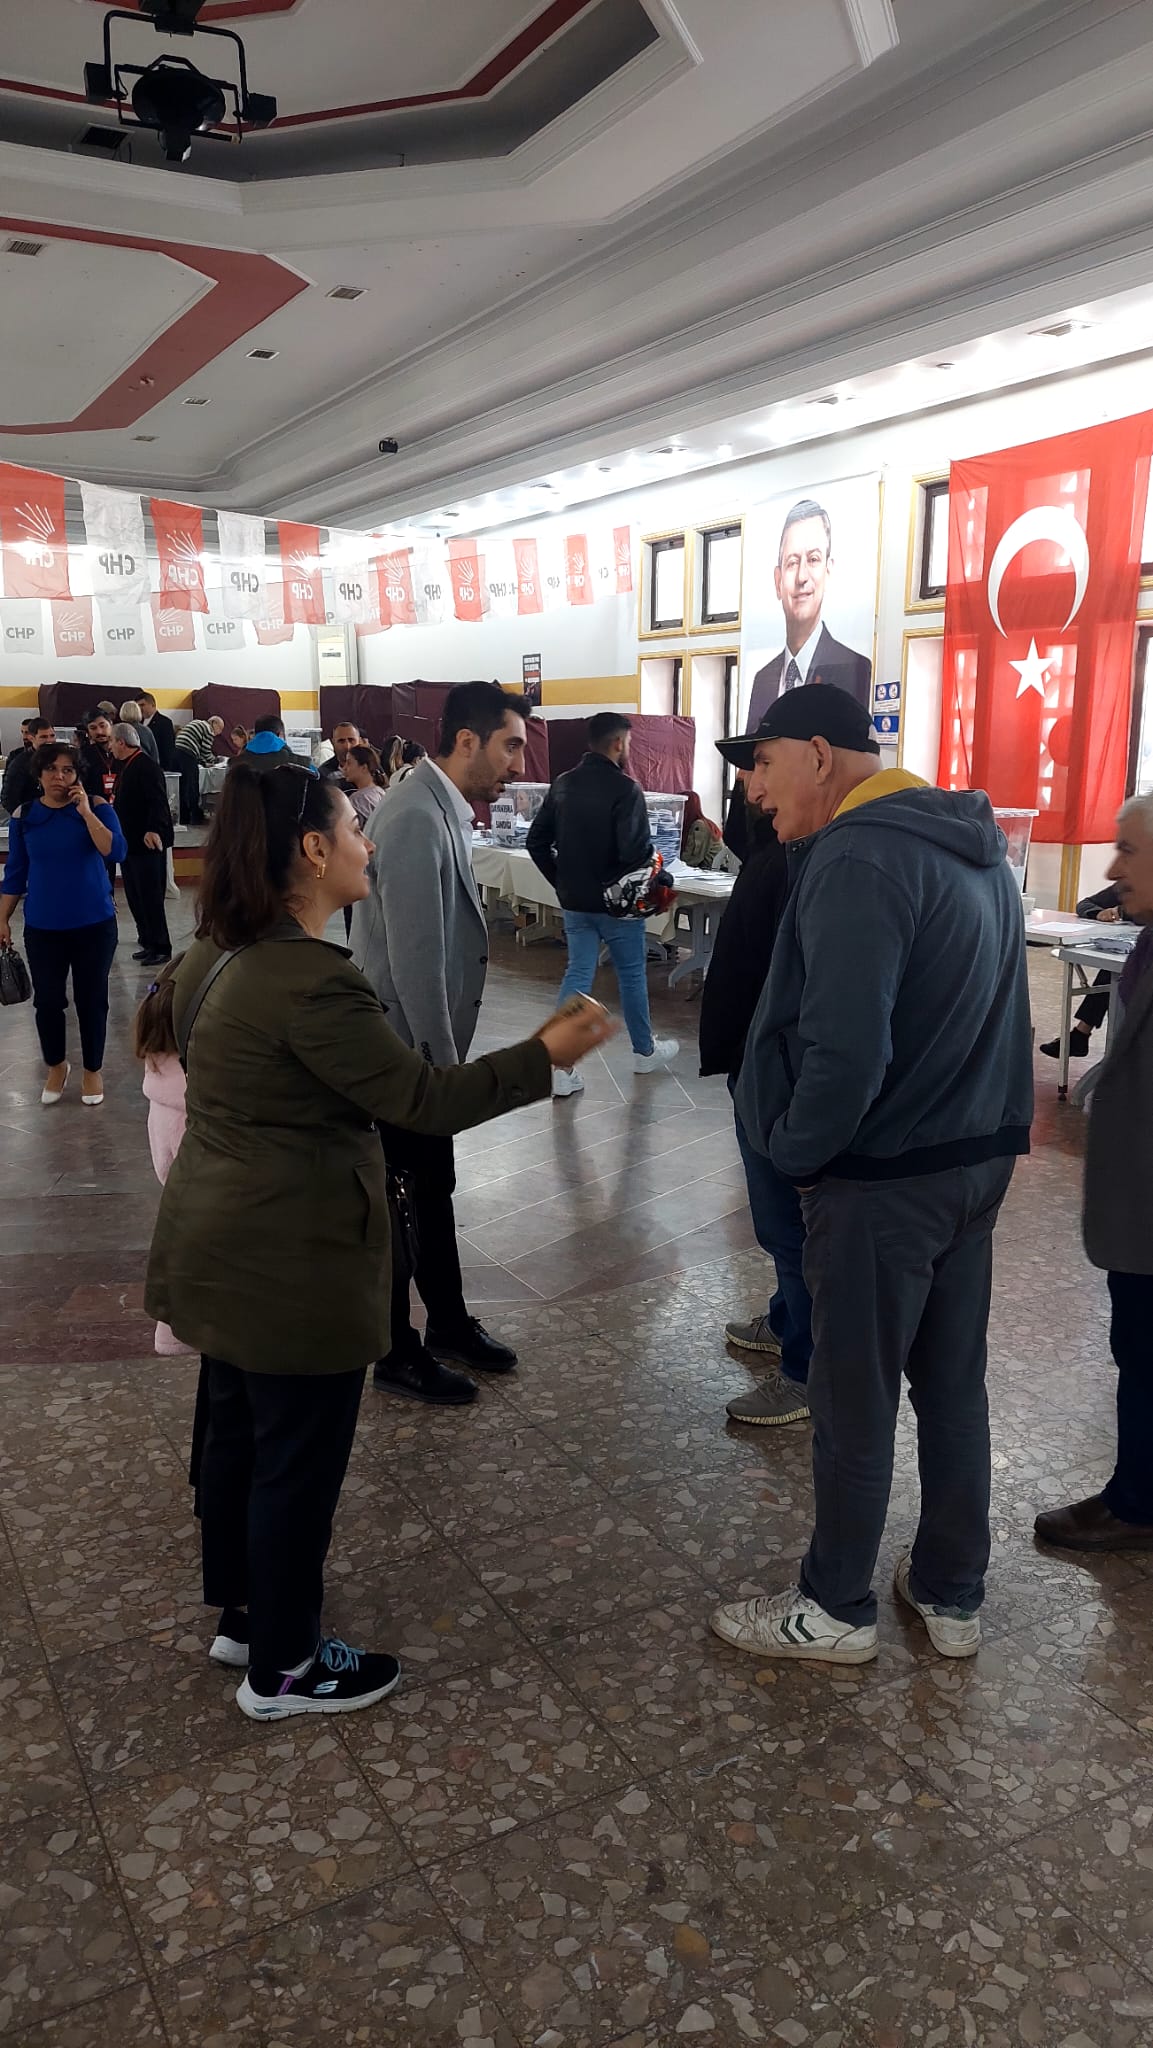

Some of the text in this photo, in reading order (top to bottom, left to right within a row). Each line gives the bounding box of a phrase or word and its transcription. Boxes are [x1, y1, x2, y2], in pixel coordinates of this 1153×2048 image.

[6, 627, 35, 640] CHP
[107, 628, 136, 640] CHP
[159, 625, 184, 637] CHP
[207, 622, 236, 635] CHP
[60, 631, 86, 642] CHP
